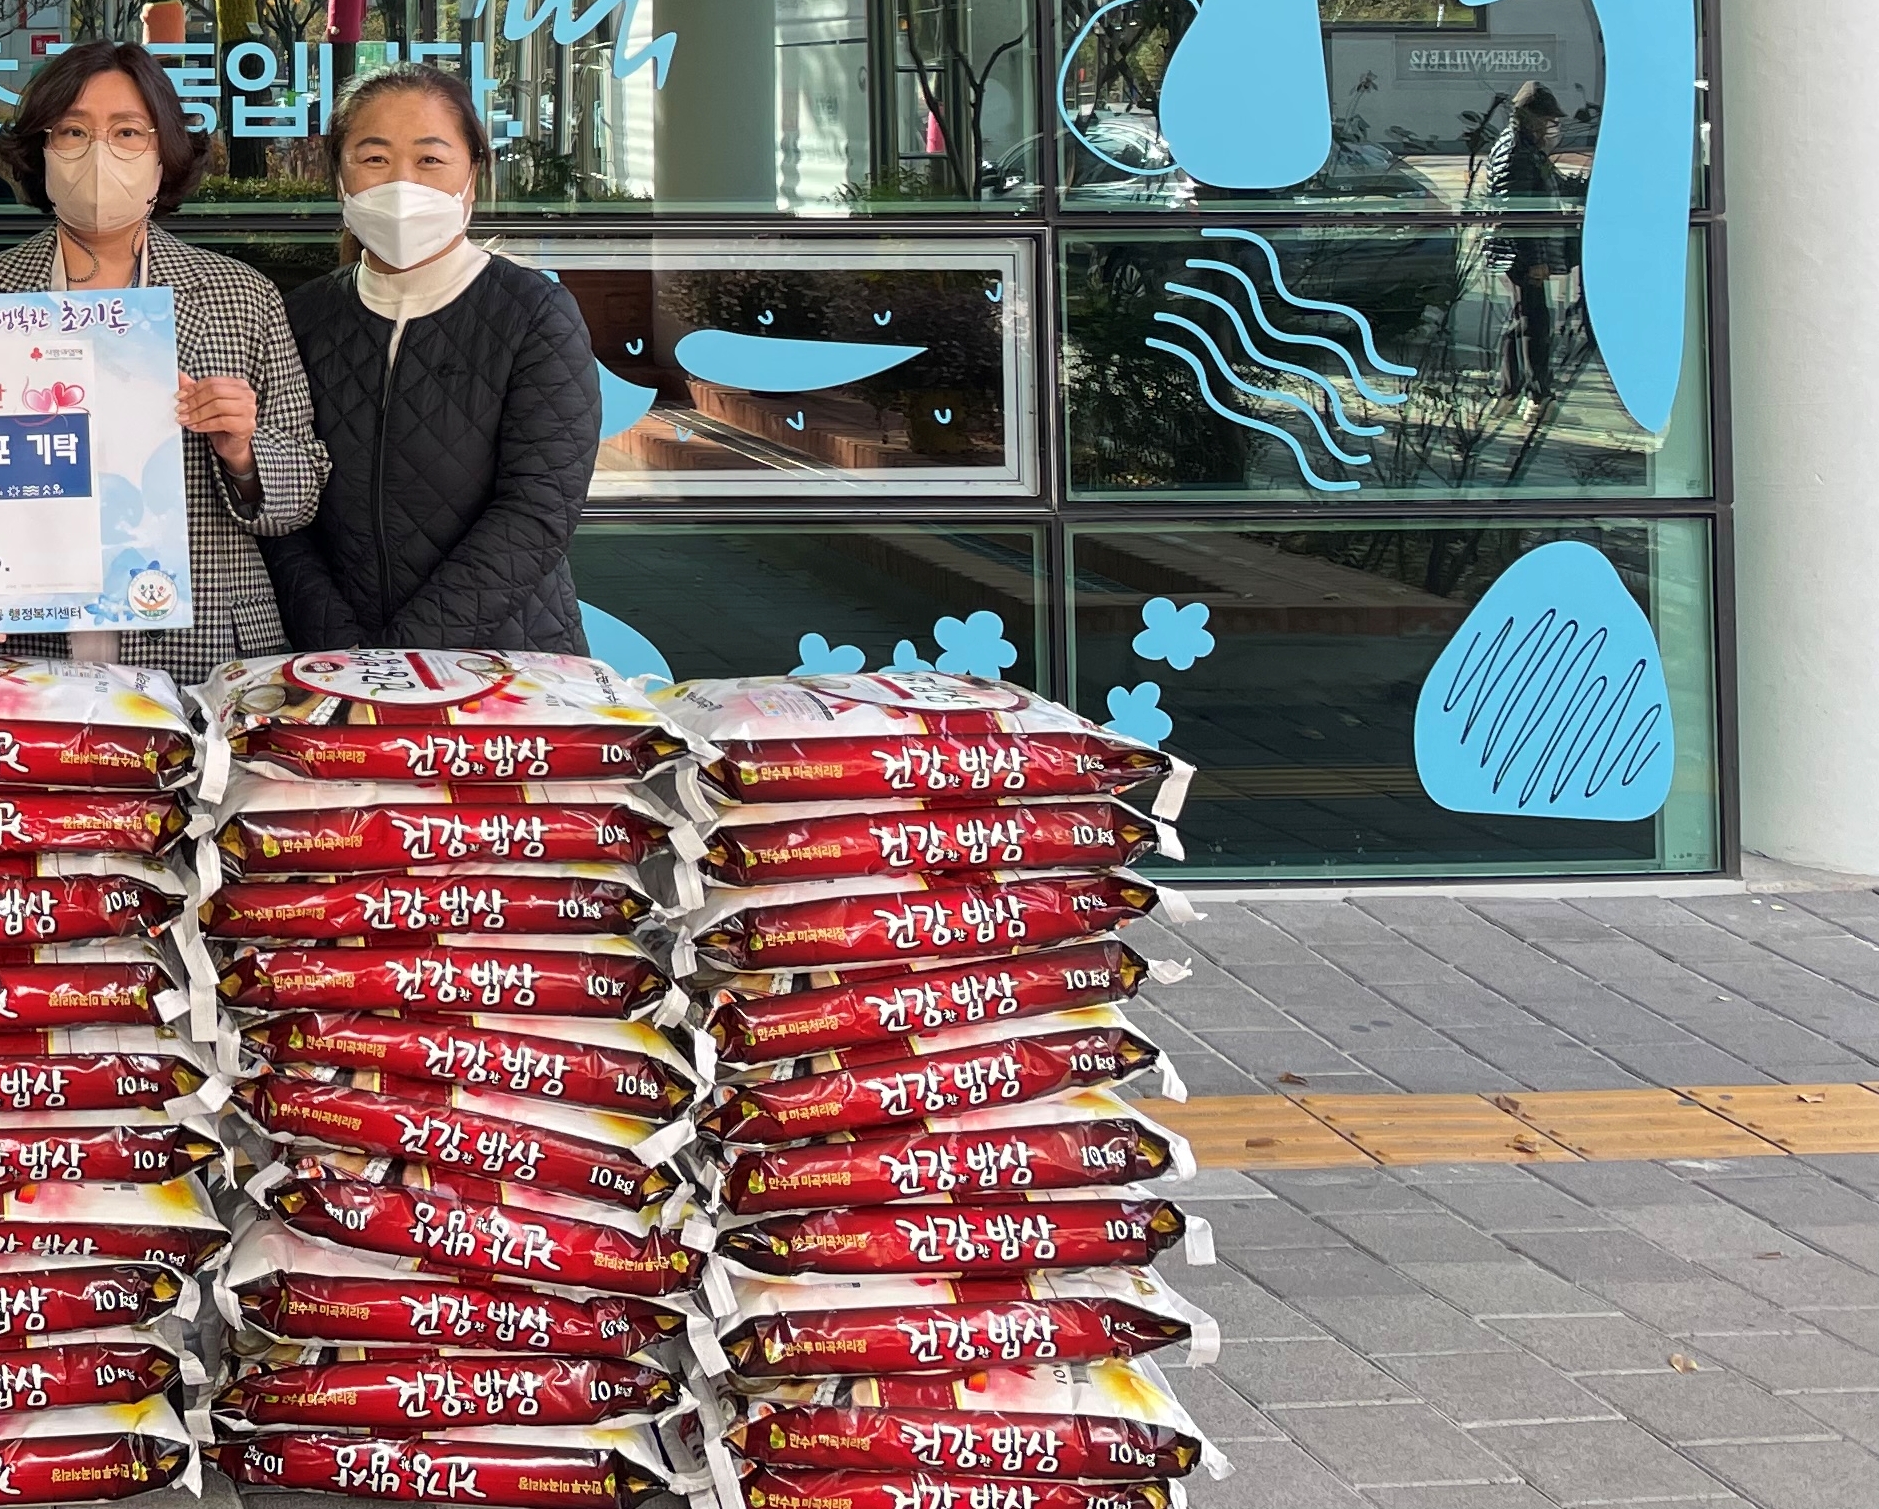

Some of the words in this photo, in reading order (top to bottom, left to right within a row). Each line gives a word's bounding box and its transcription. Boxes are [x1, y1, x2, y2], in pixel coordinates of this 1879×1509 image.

[61, 299, 132, 334] 초지동
[26, 433, 79, 466] 기탁
[8, 604, 83, 622] 행정복지센터
[484, 737, 553, 775] 밥상
[959, 746, 1028, 789] 밥상
[439, 885, 508, 928] 밥상
[954, 974, 1020, 1020] 밥상
[477, 1127, 545, 1181] 밥상
[967, 1143, 1036, 1185] 밥상
[987, 1319, 1058, 1357] 밥상
[991, 1427, 1063, 1472] 밥상
